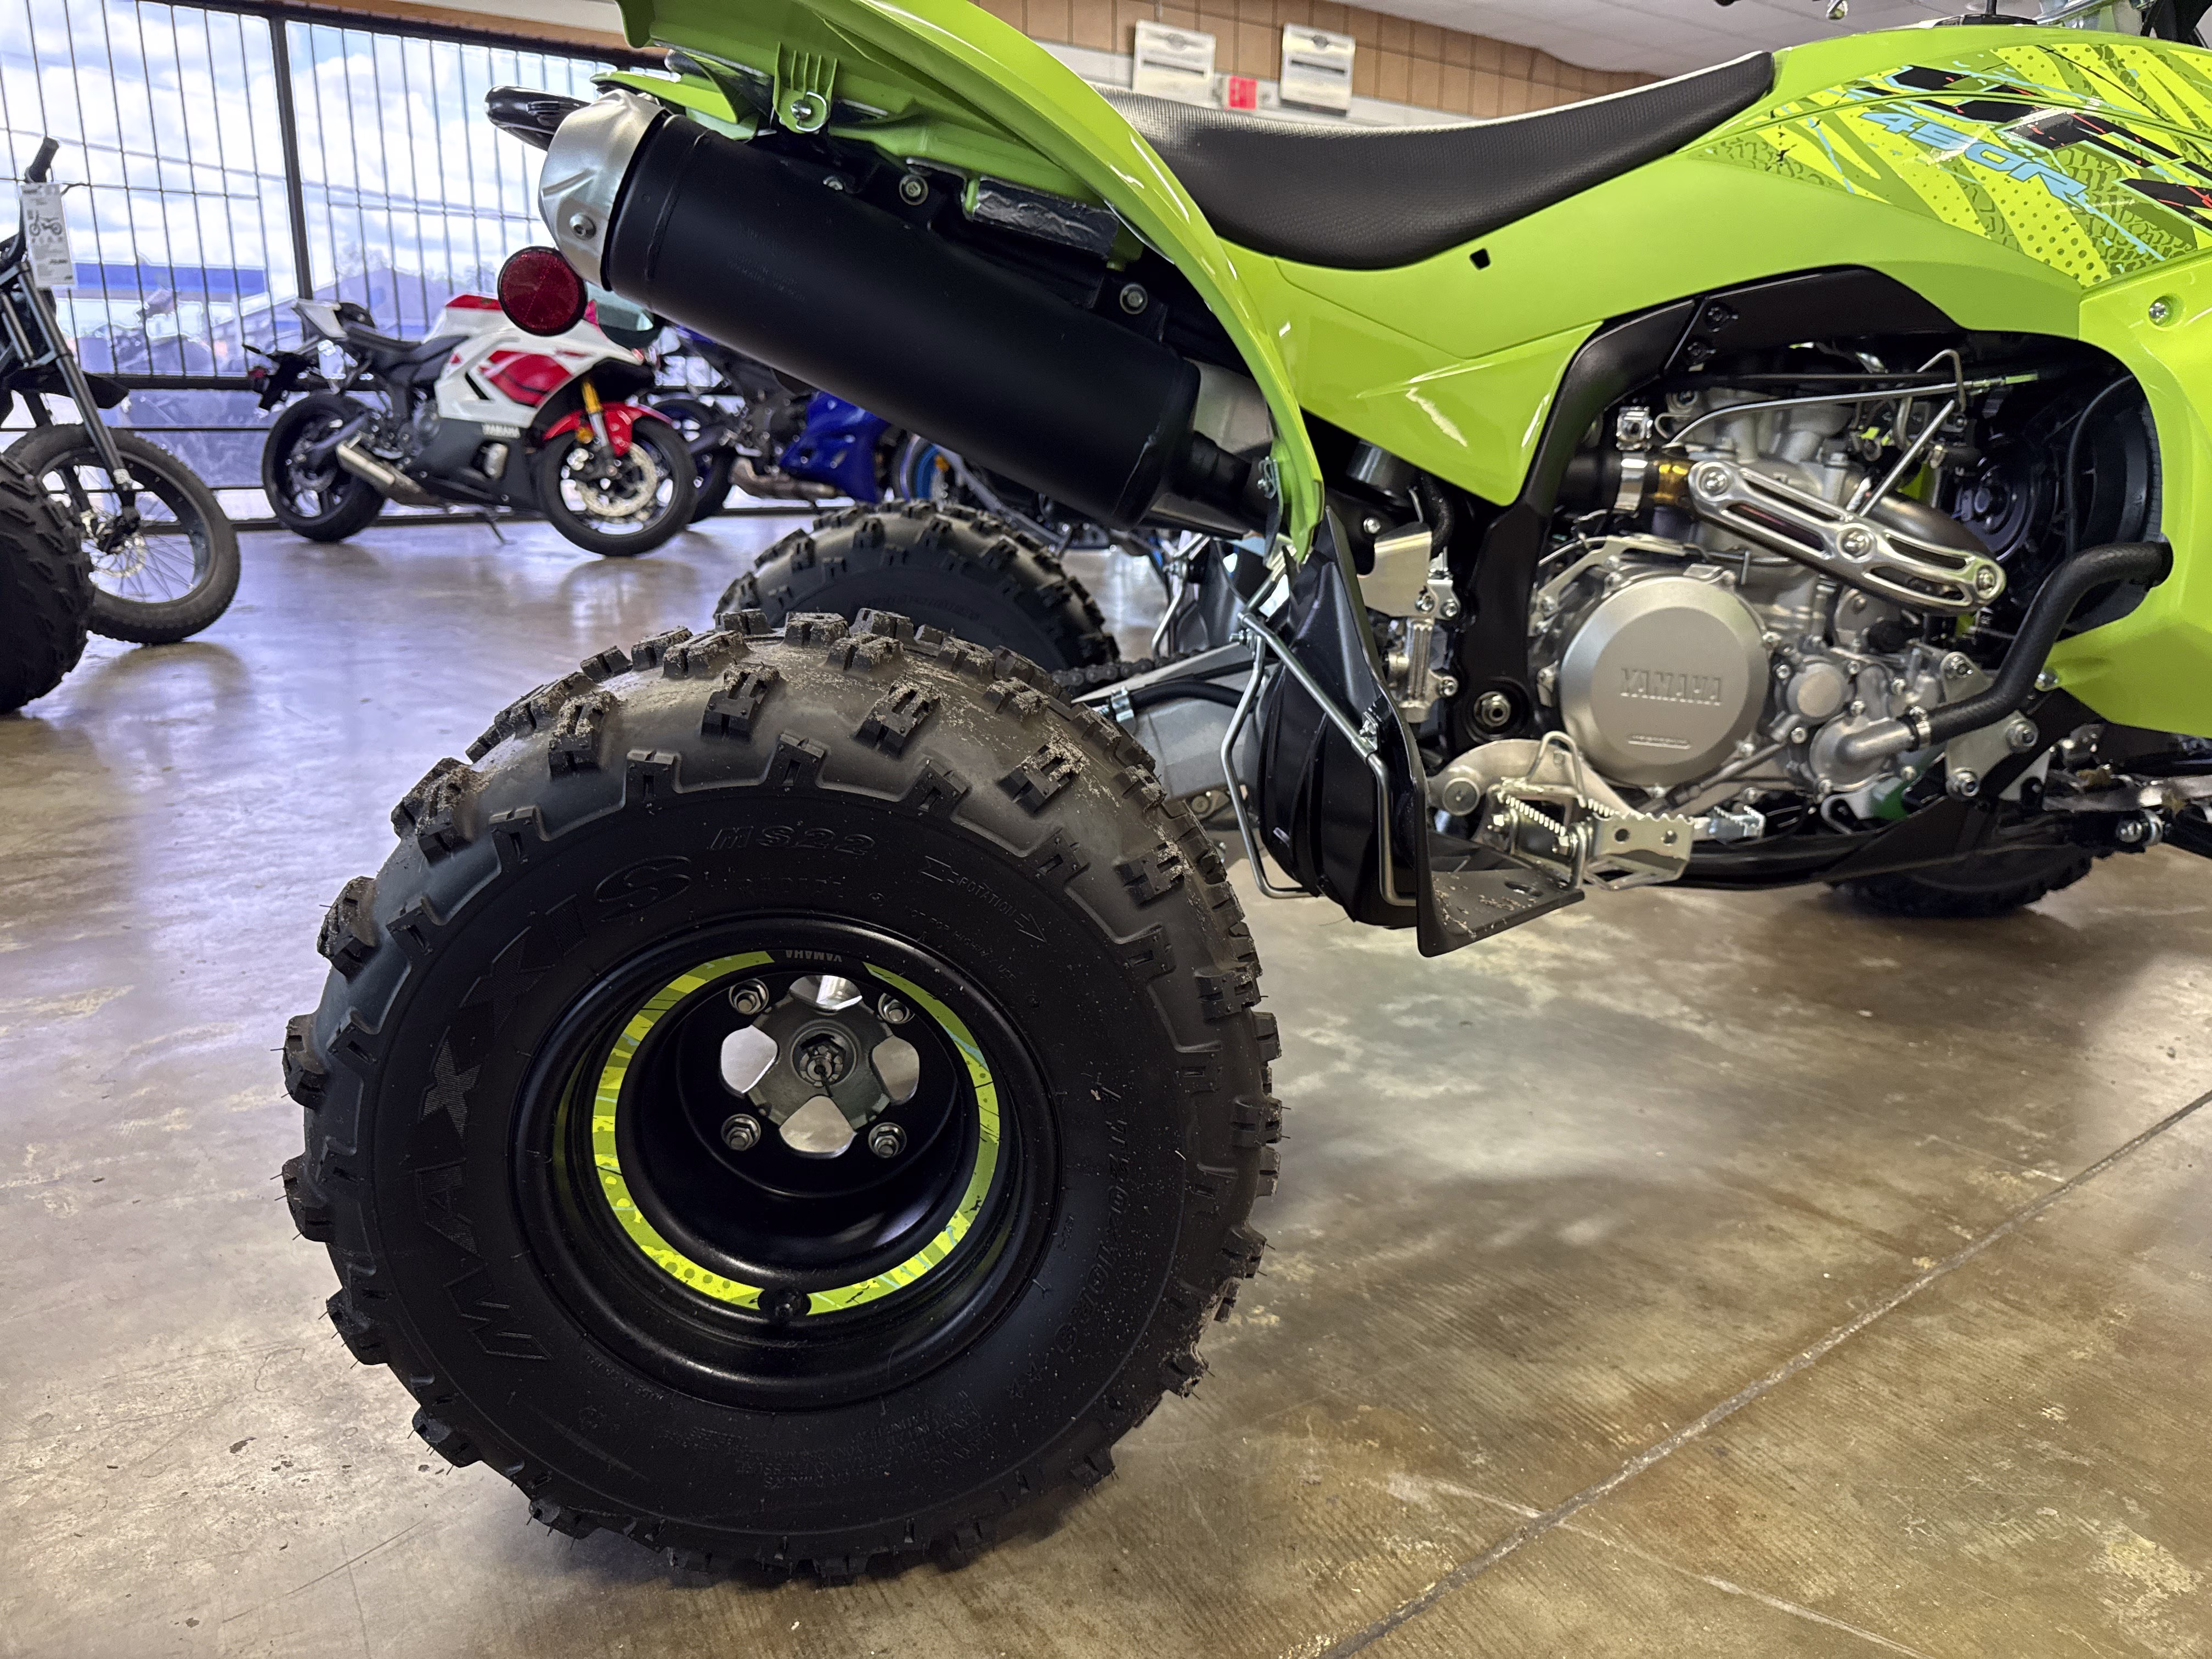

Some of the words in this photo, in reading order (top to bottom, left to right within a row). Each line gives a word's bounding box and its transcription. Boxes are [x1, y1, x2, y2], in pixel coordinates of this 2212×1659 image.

[1859, 111, 2087, 208] 450R
[481, 423, 521, 438] YAMAHA
[1620, 667, 1722, 707] YAMAHA
[708, 825, 877, 856] MS22
[957, 876, 1018, 917] ROTATION
[785, 949, 843, 963] YAMAHA
[415, 855, 692, 1361] MAXXIS
